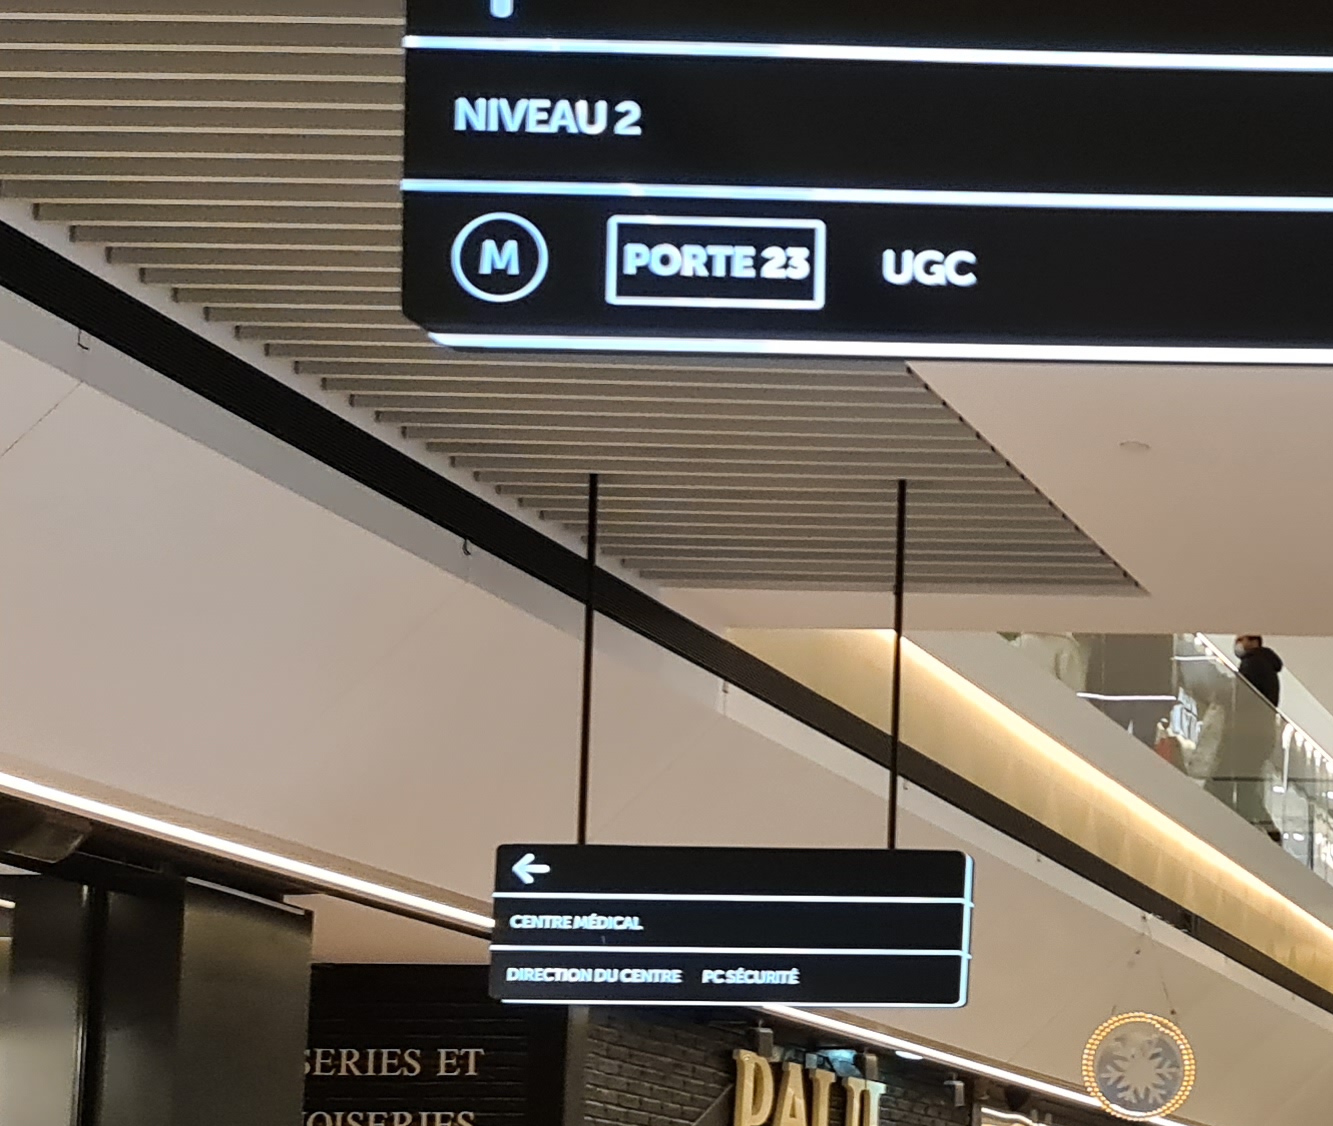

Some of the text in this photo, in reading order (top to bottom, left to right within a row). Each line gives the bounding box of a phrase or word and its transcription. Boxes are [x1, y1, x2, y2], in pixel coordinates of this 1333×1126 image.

[454, 97, 643, 137] NIVEAU 2
[478, 239, 520, 276] M
[622, 243, 811, 280] PORTE 23
[881, 248, 978, 287] UGC
[509, 912, 644, 931] CENTRE MÉDICAL
[506, 967, 683, 983] DIRECTION DU CENTRE
[702, 966, 801, 984] PC SÉCURITÉ
[436, 1048, 485, 1076] ET
